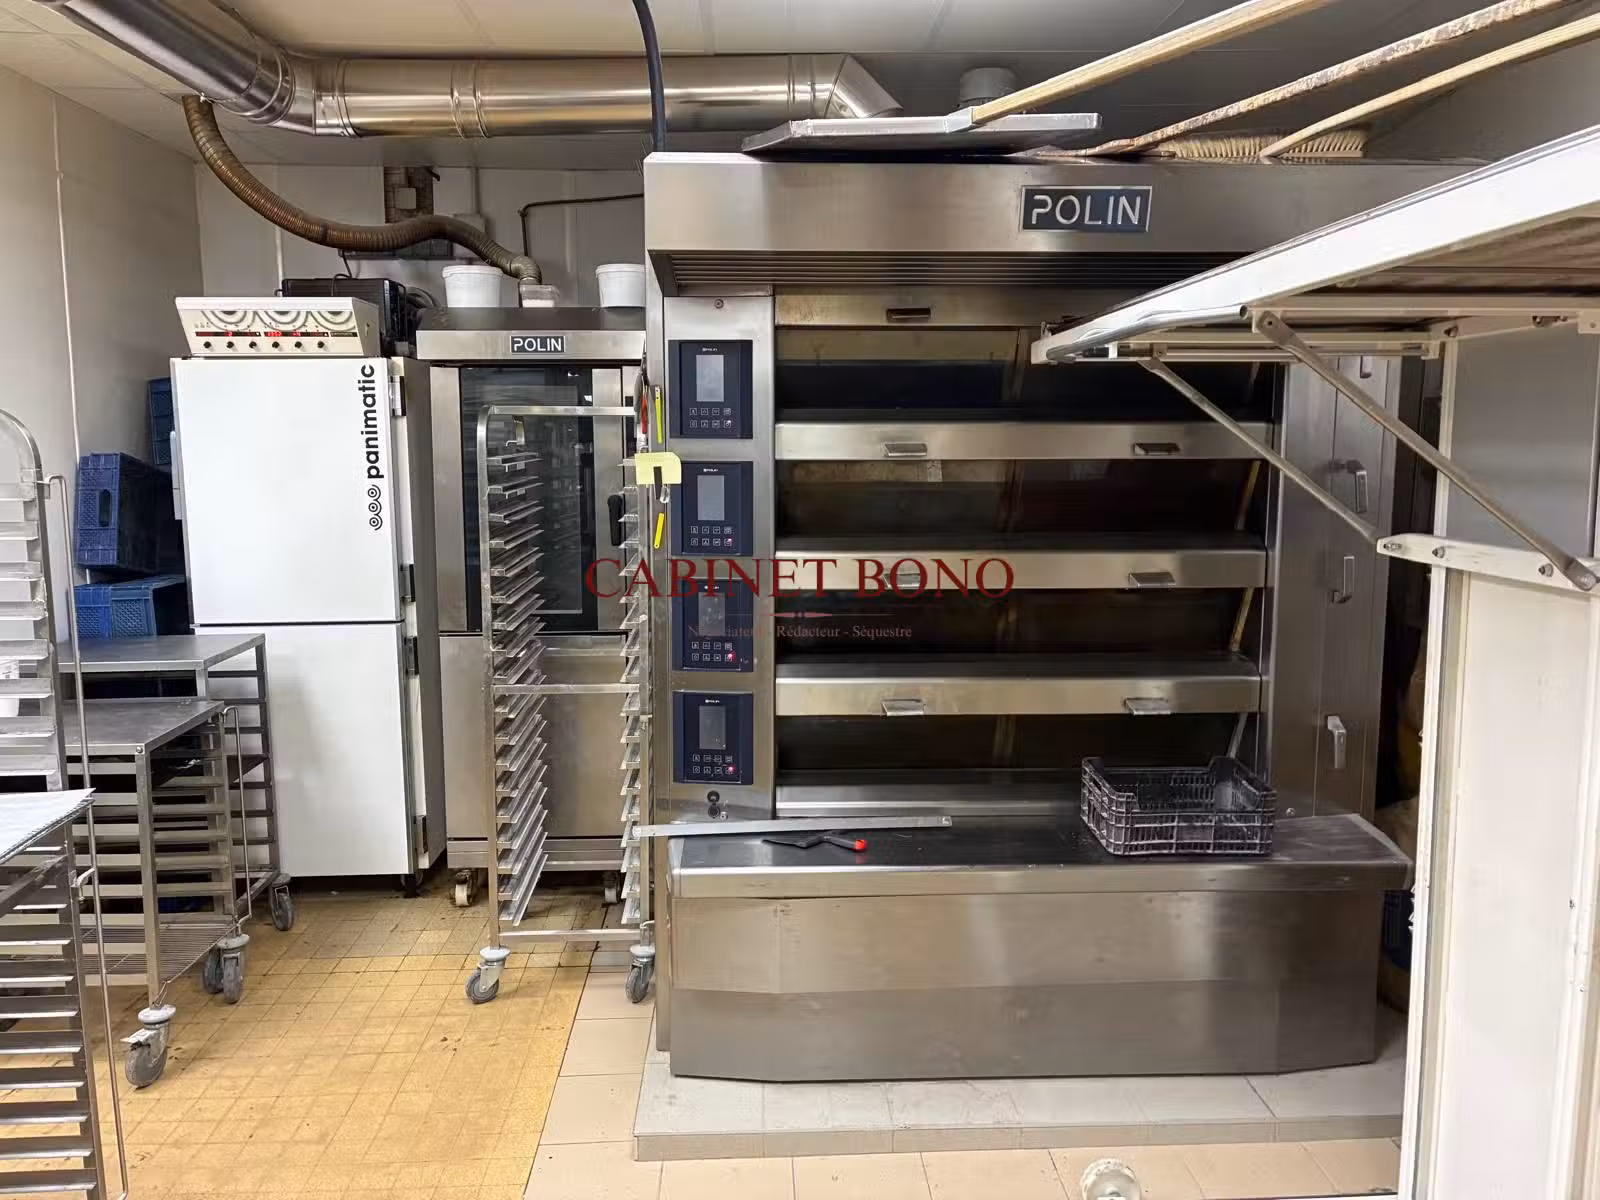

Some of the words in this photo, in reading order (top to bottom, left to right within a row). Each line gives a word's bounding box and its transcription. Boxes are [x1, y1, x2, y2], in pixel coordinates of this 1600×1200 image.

[1031, 194, 1141, 225] POLIN
[513, 337, 562, 352] POLIN
[357, 364, 385, 479] panimatic
